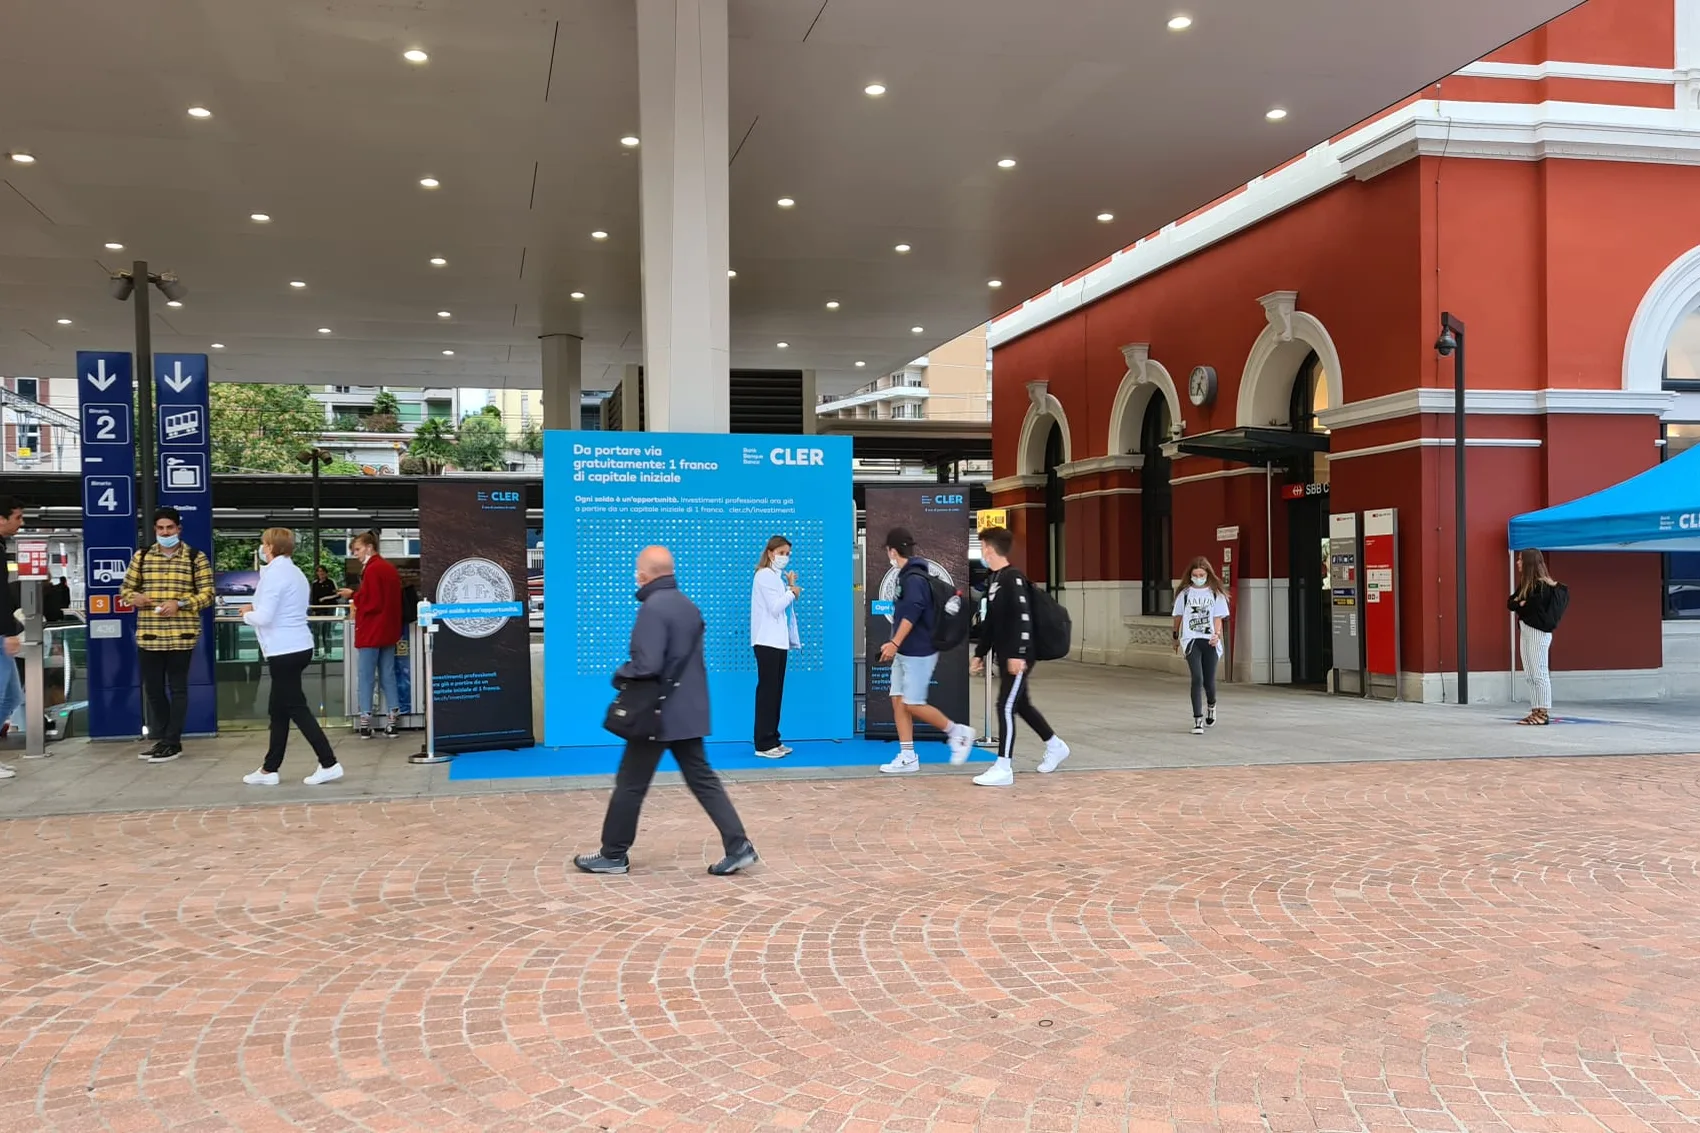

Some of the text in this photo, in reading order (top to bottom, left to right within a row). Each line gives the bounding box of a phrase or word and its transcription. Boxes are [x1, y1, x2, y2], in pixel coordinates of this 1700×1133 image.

[96, 415, 116, 439] 2
[573, 444, 662, 457] Da portare via
[770, 447, 824, 466] CLER
[573, 458, 718, 470] gratuitamente: 1 franco
[573, 471, 681, 484] di capitale iniziale
[1305, 483, 1322, 496] SBB
[97, 488, 118, 511] 4
[491, 491, 520, 502] CLER
[575, 495, 593, 503] Ogni
[681, 496, 724, 504] Investimenti
[725, 497, 768, 505] professionali
[935, 495, 963, 504] CLER
[582, 505, 606, 513] partire
[630, 505, 659, 513] capitale
[660, 505, 684, 513] iniziale
[1679, 513, 1700, 529] CL
[96, 599, 104, 608] 3
